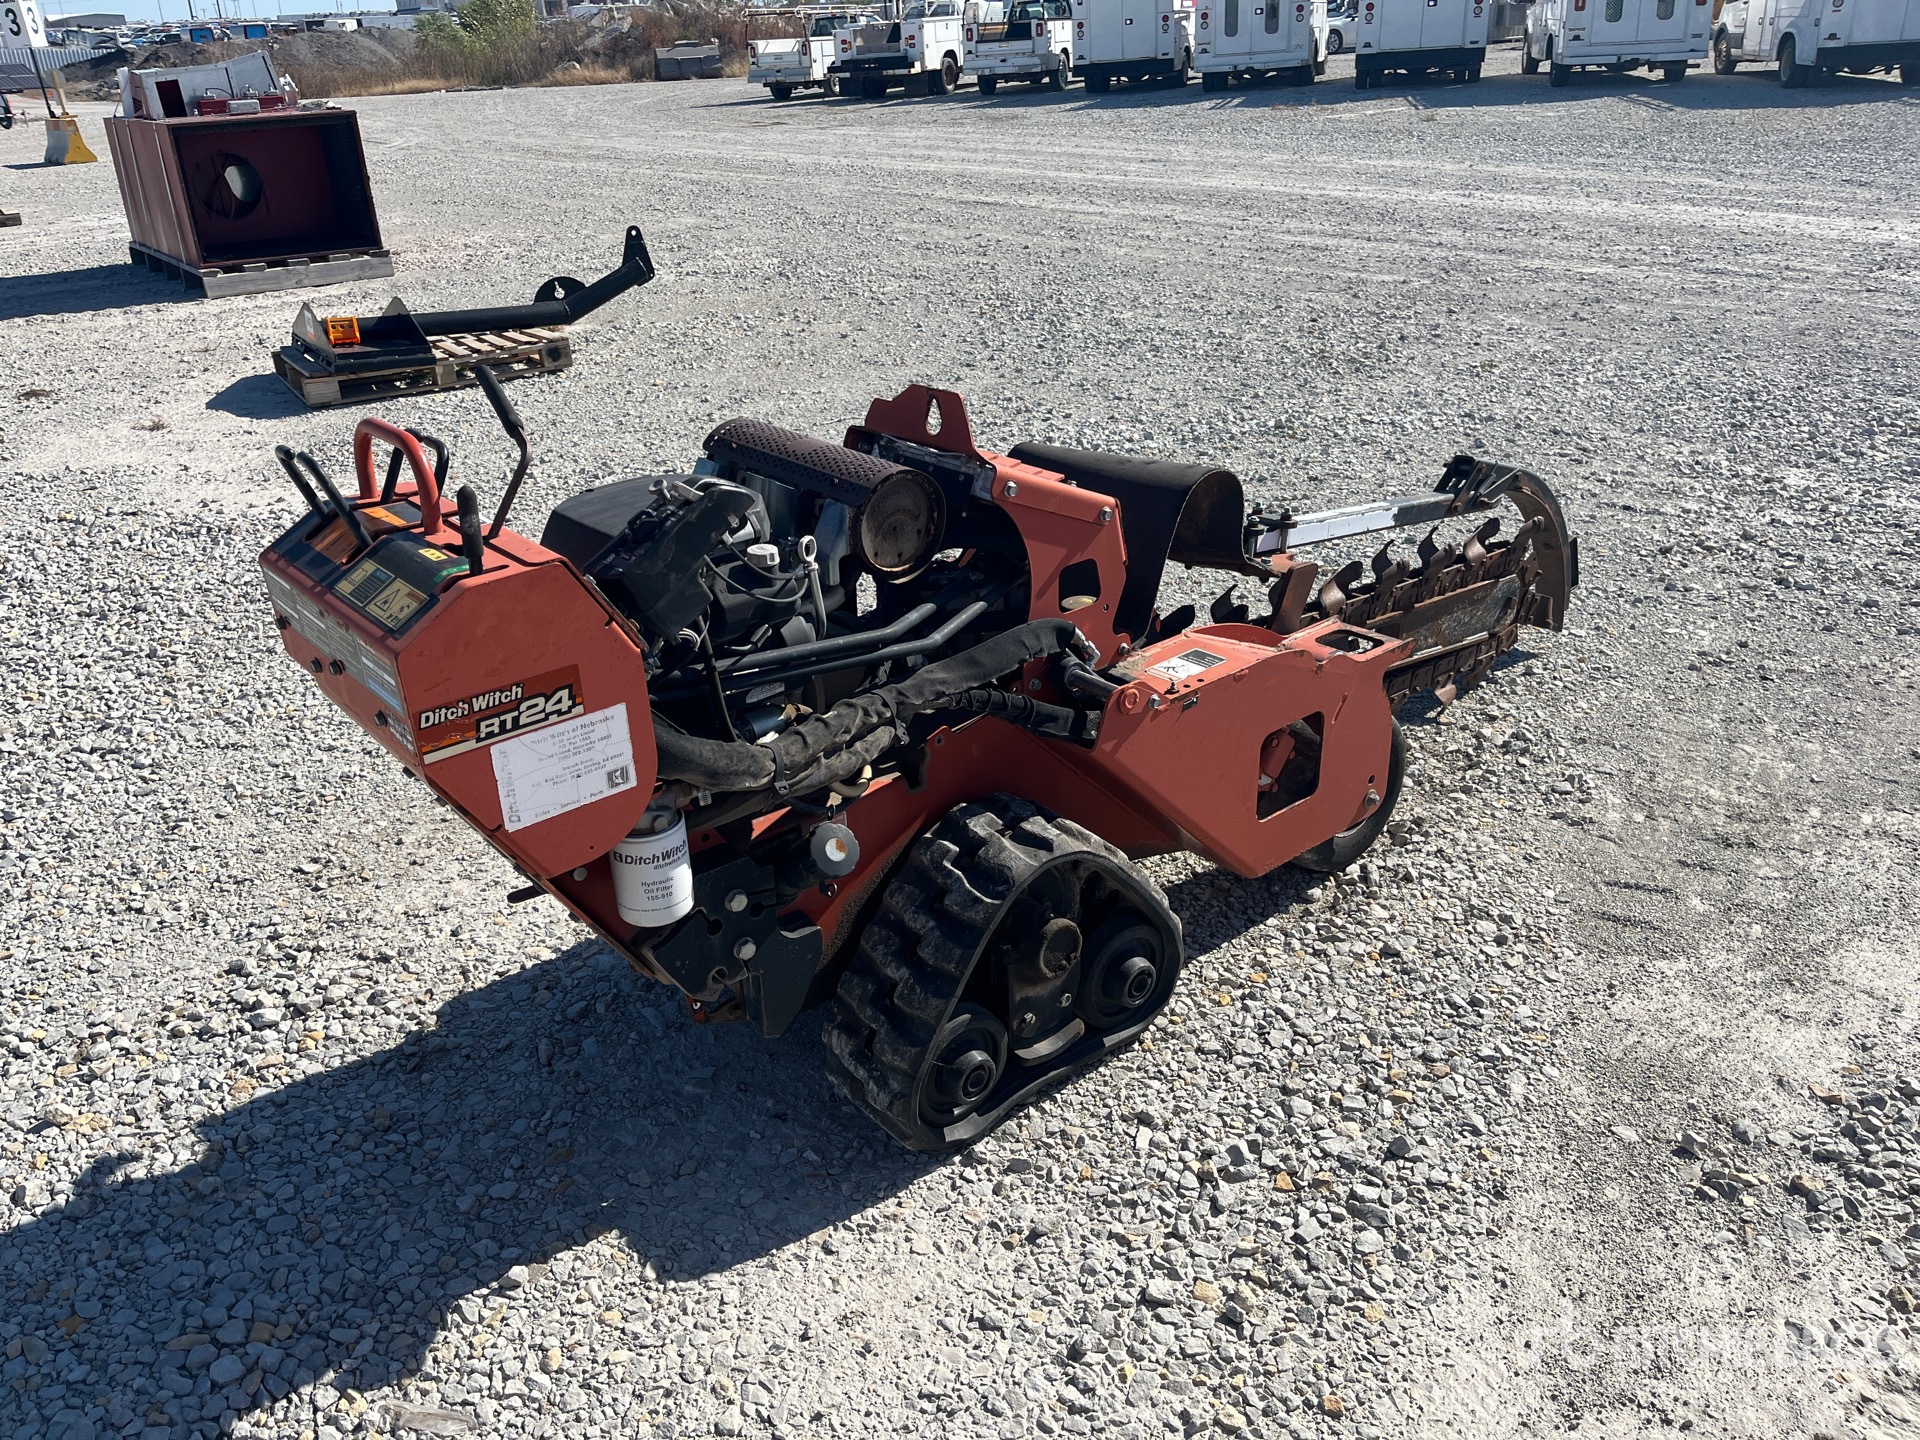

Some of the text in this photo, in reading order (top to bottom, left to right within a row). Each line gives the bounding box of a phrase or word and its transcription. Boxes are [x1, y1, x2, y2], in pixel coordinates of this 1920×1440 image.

[5, 8, 21, 37] 3
[27, 7, 38, 35] 3
[420, 684, 523, 730] Ditch Witch
[479, 688, 573, 739] RT24
[580, 713, 614, 730] Nebraska
[624, 839, 687, 866] Ditch Witch
[641, 876, 675, 888] Hydraulic
[643, 884, 674, 895] Oil Filter
[646, 891, 673, 901] 155-910
